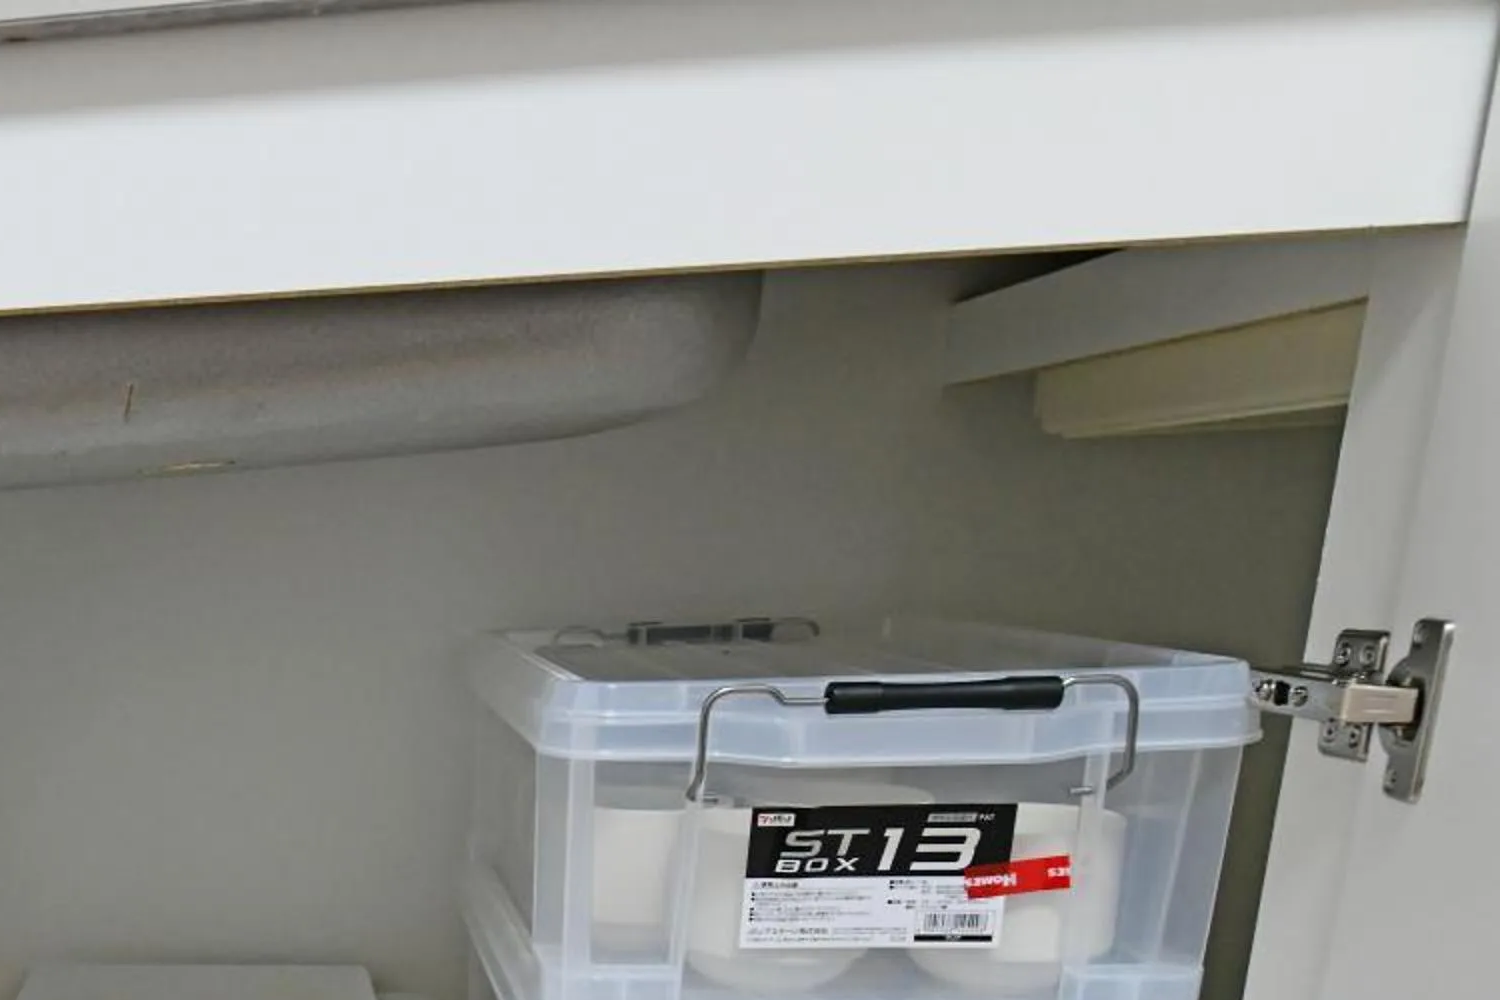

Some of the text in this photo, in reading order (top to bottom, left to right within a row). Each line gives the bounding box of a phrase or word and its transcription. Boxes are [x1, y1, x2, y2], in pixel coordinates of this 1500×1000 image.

[775, 856, 860, 874] BOX
[780, 827, 982, 872] ST 13
